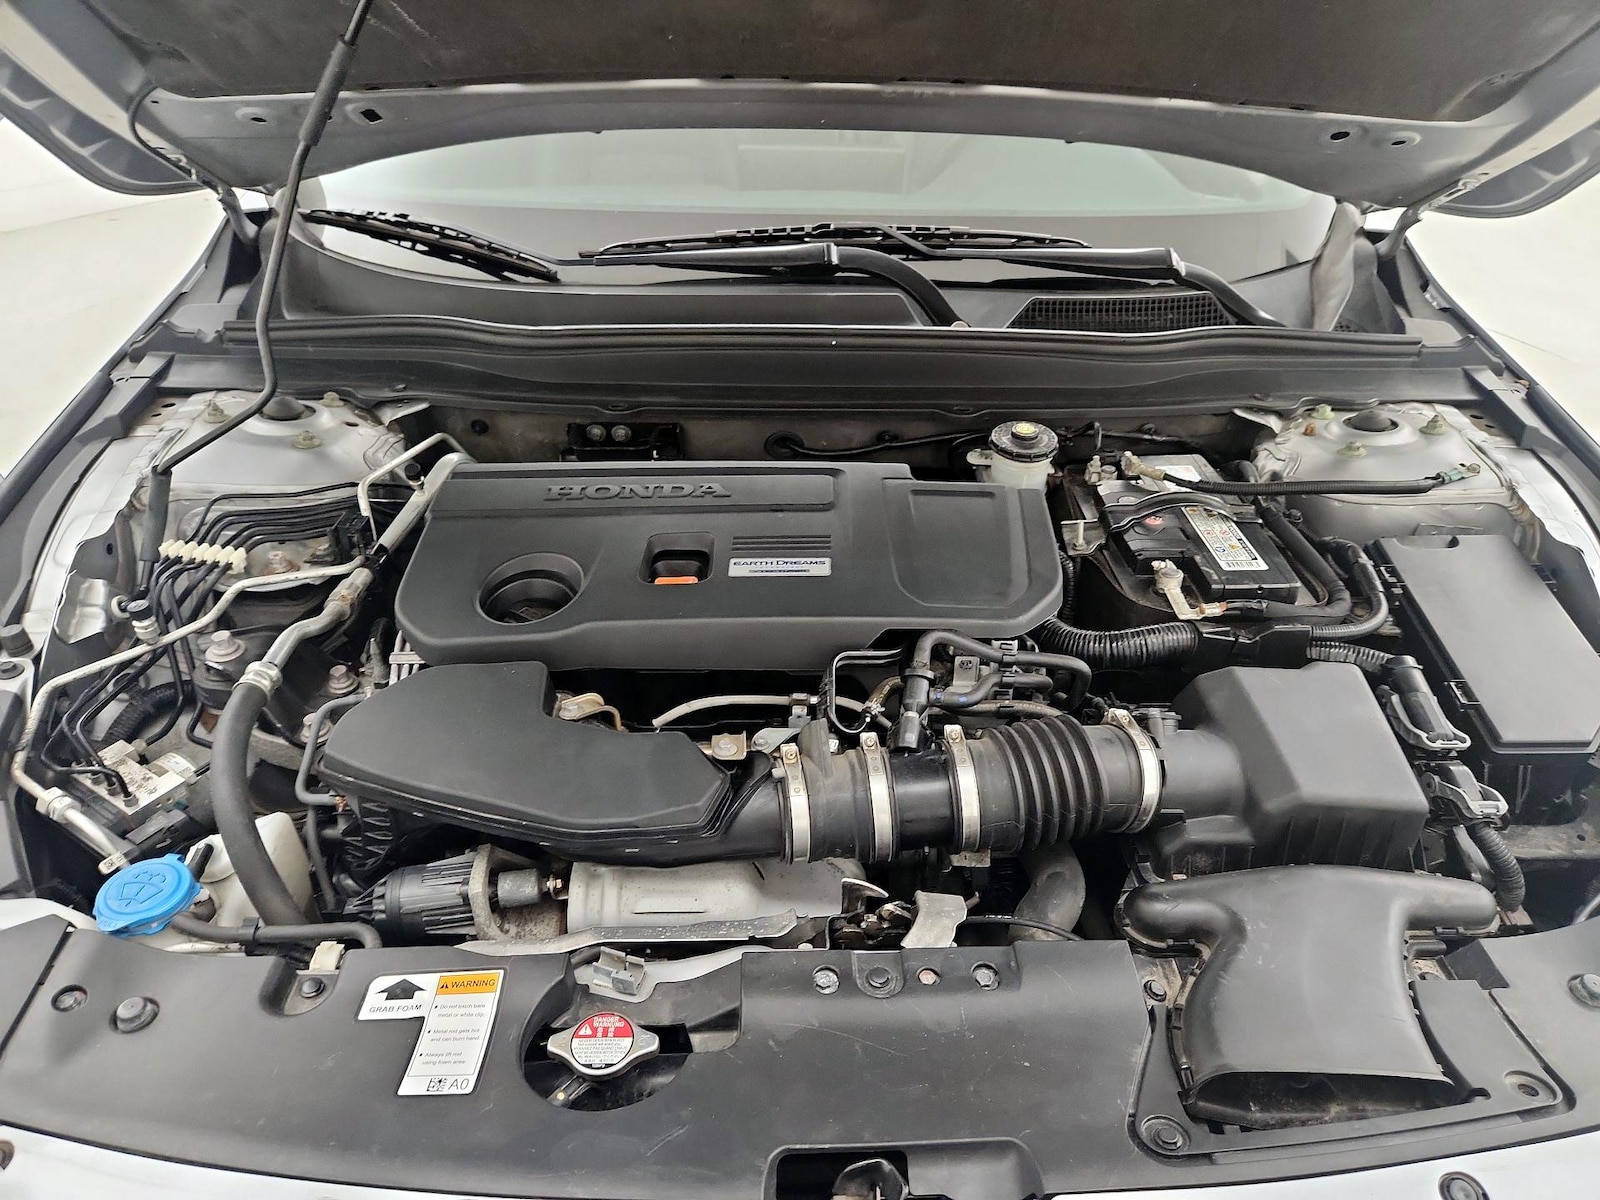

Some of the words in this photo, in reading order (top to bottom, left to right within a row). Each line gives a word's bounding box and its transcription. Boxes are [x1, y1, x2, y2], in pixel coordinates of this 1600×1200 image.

[545, 482, 732, 500] HONDA
[450, 978, 496, 988] WARNING
[369, 1005, 395, 1013] GRAB
[396, 1004, 422, 1012] FOAM
